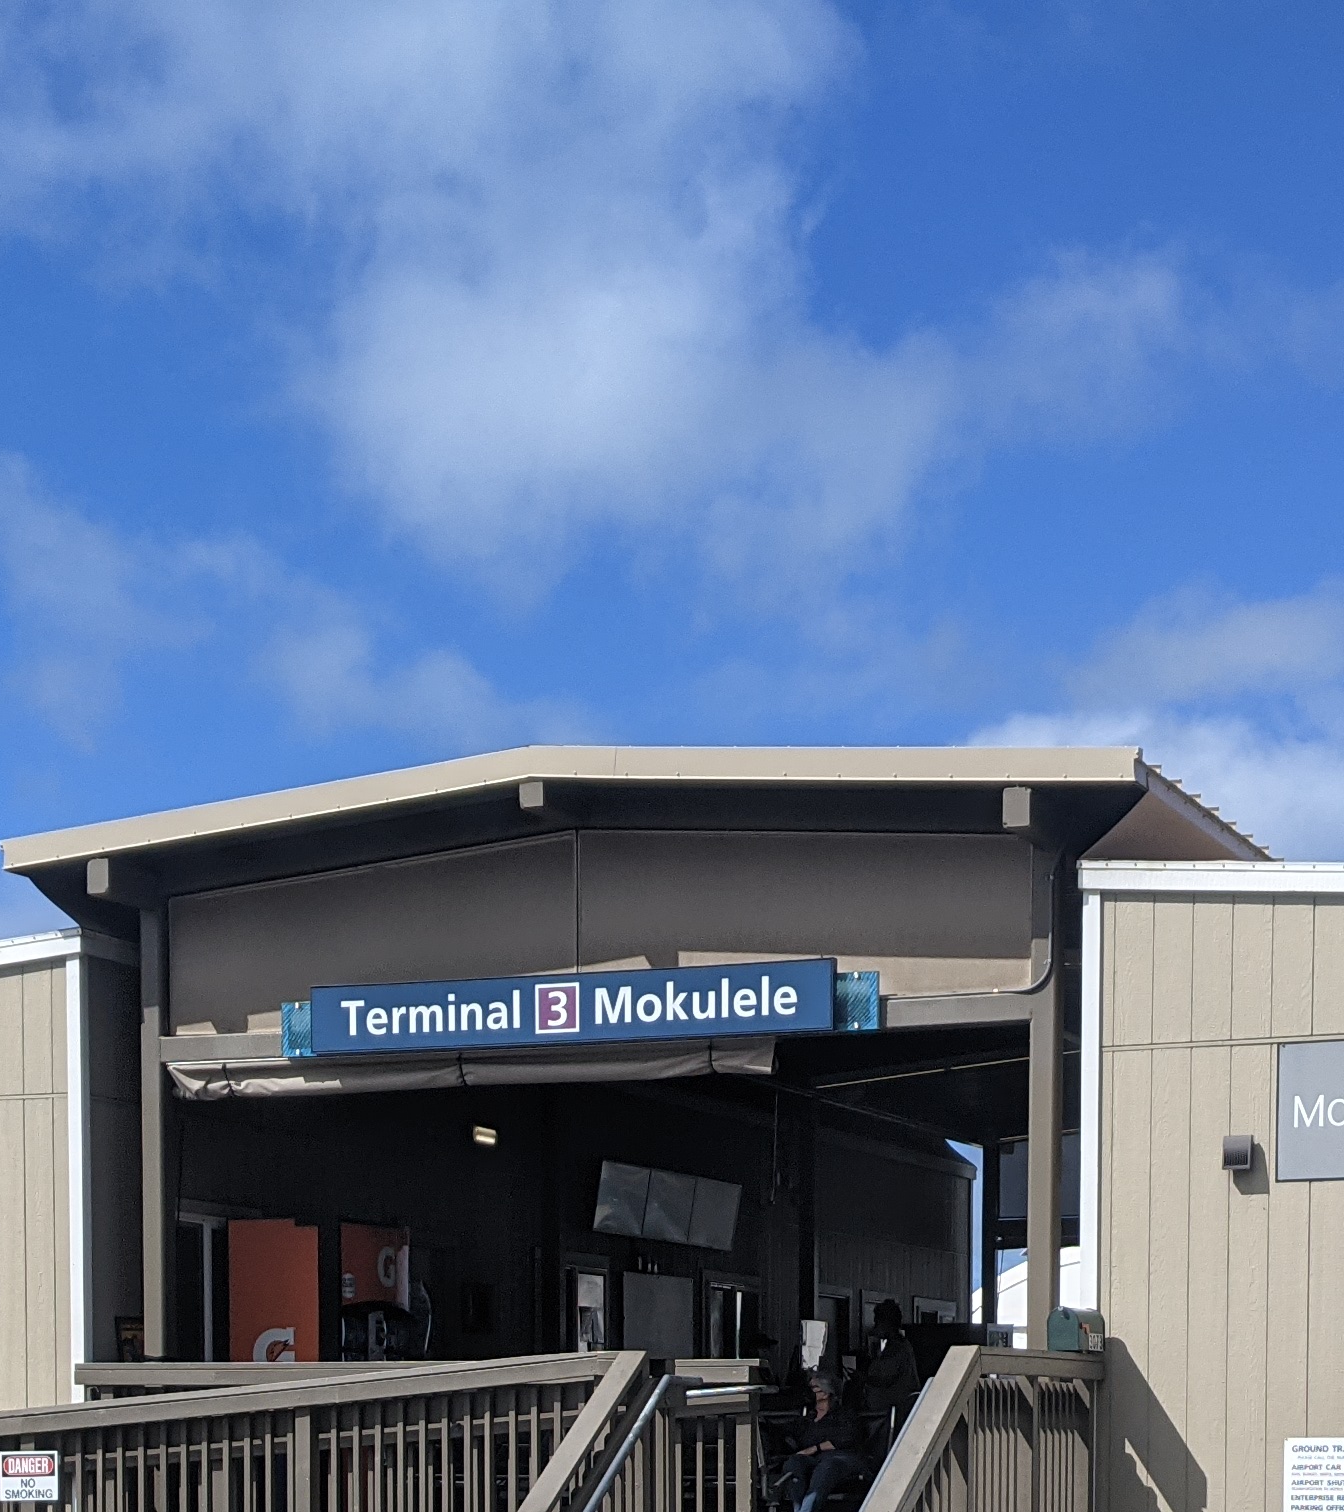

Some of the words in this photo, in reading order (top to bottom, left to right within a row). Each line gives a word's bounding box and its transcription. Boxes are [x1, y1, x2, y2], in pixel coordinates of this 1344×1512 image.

[340, 990, 522, 1036] Terminal
[546, 990, 569, 1028] 3
[594, 976, 798, 1025] Mokulele
[1292, 1445, 1329, 1453] GROUND
[8, 1457, 49, 1474] DANGER
[20, 1478, 36, 1488] NO
[4, 1489, 53, 1499] SMOKING
[1290, 1504, 1323, 1512] PARKING
